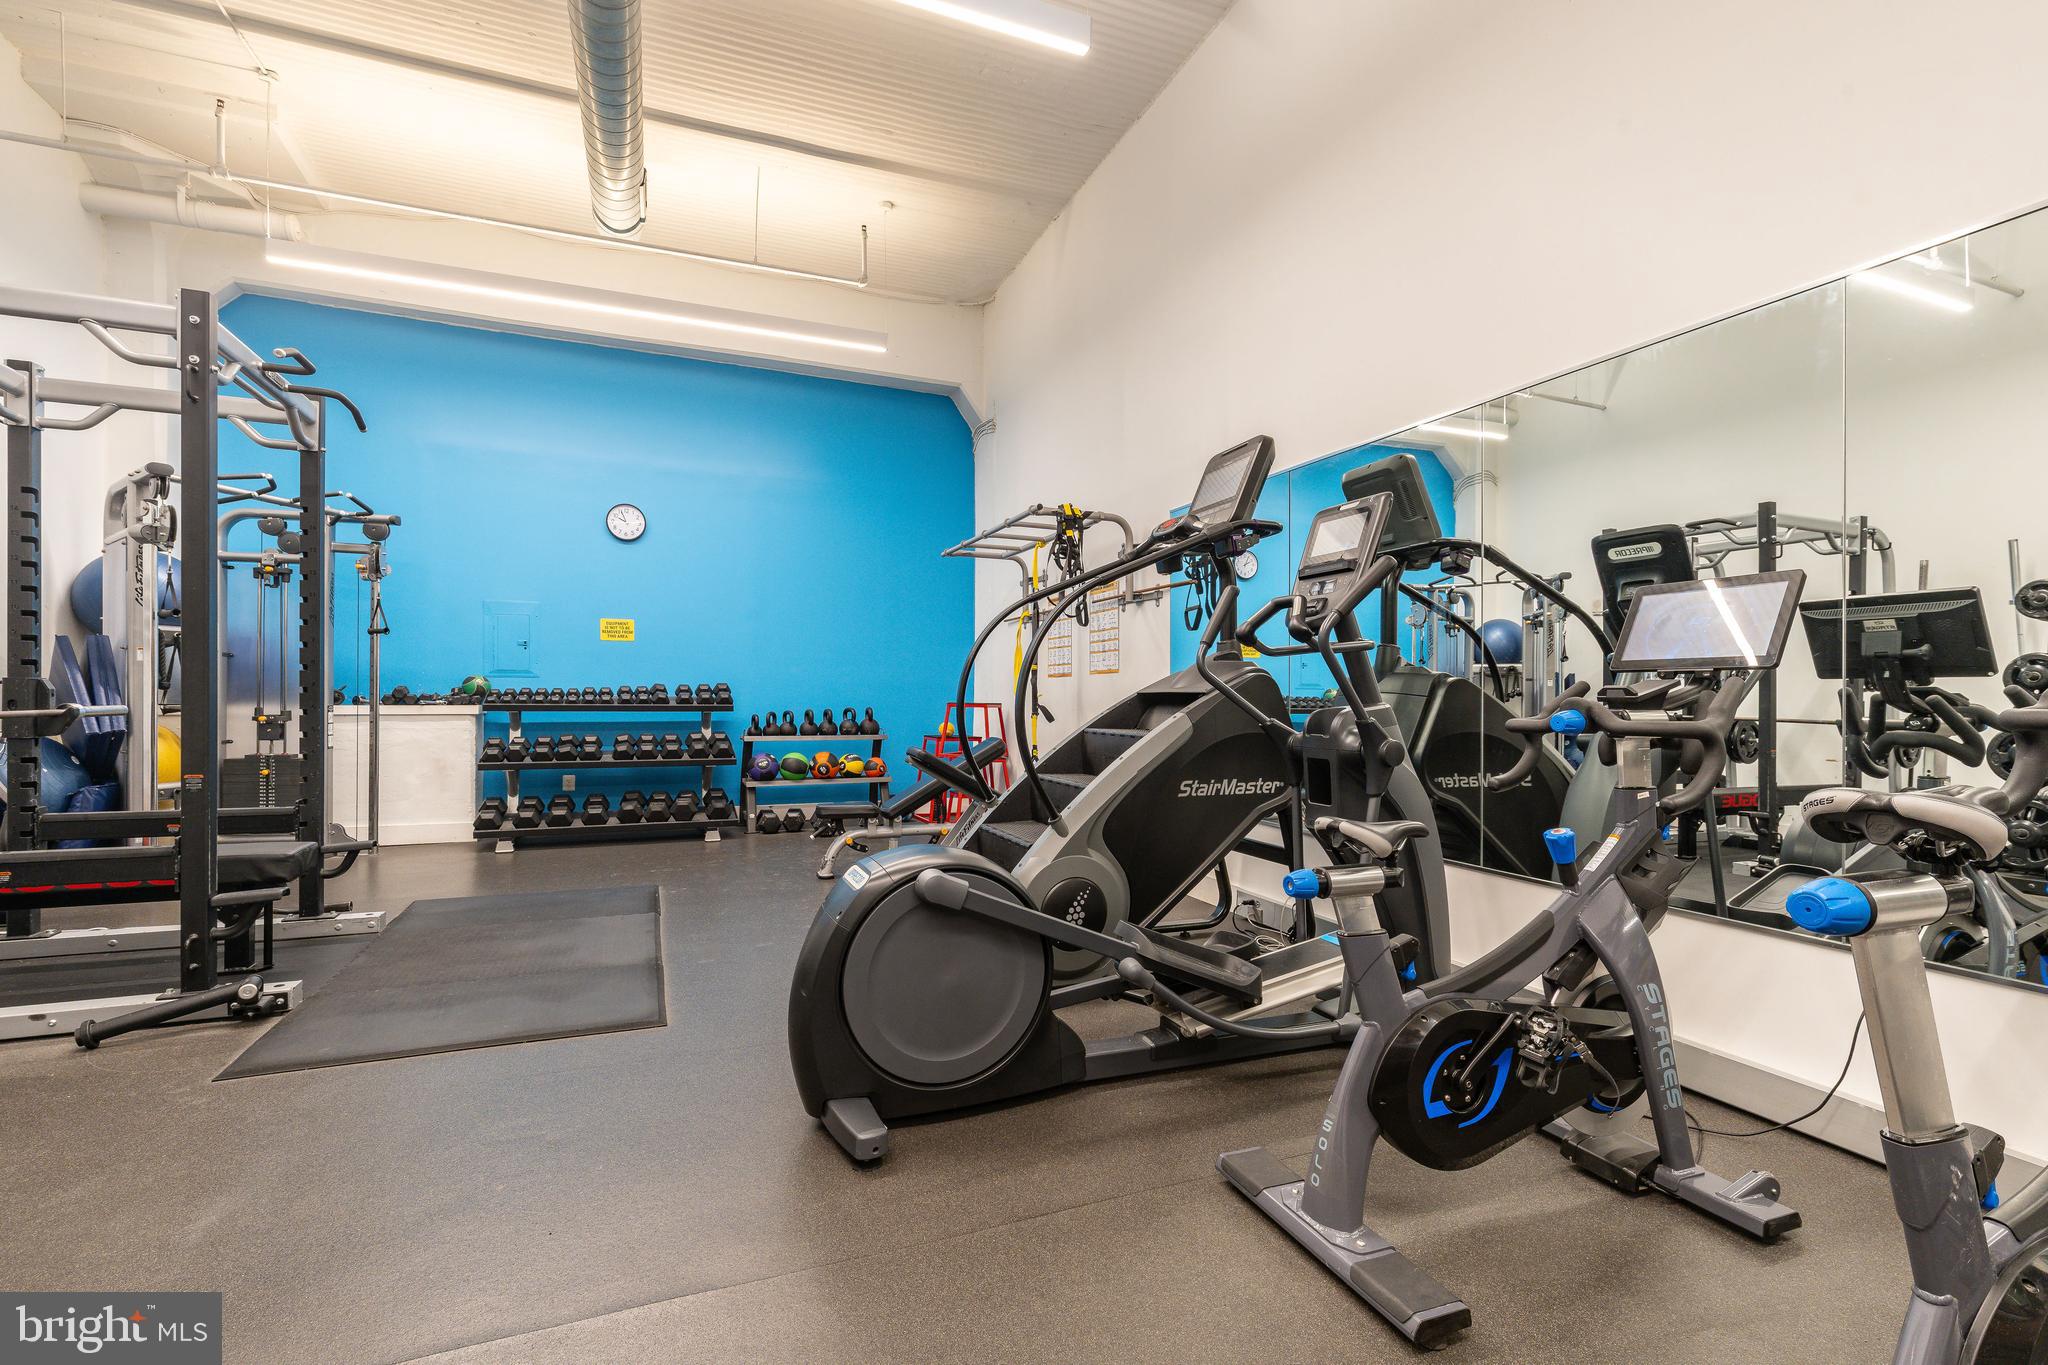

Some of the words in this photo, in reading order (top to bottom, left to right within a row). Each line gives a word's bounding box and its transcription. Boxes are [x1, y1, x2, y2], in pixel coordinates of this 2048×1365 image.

[1178, 778, 1280, 798] StairMaster
[1803, 796, 1834, 812] STAGES
[1643, 983, 1682, 1109] STAGES
[1311, 1118, 1334, 1187] SOLO
